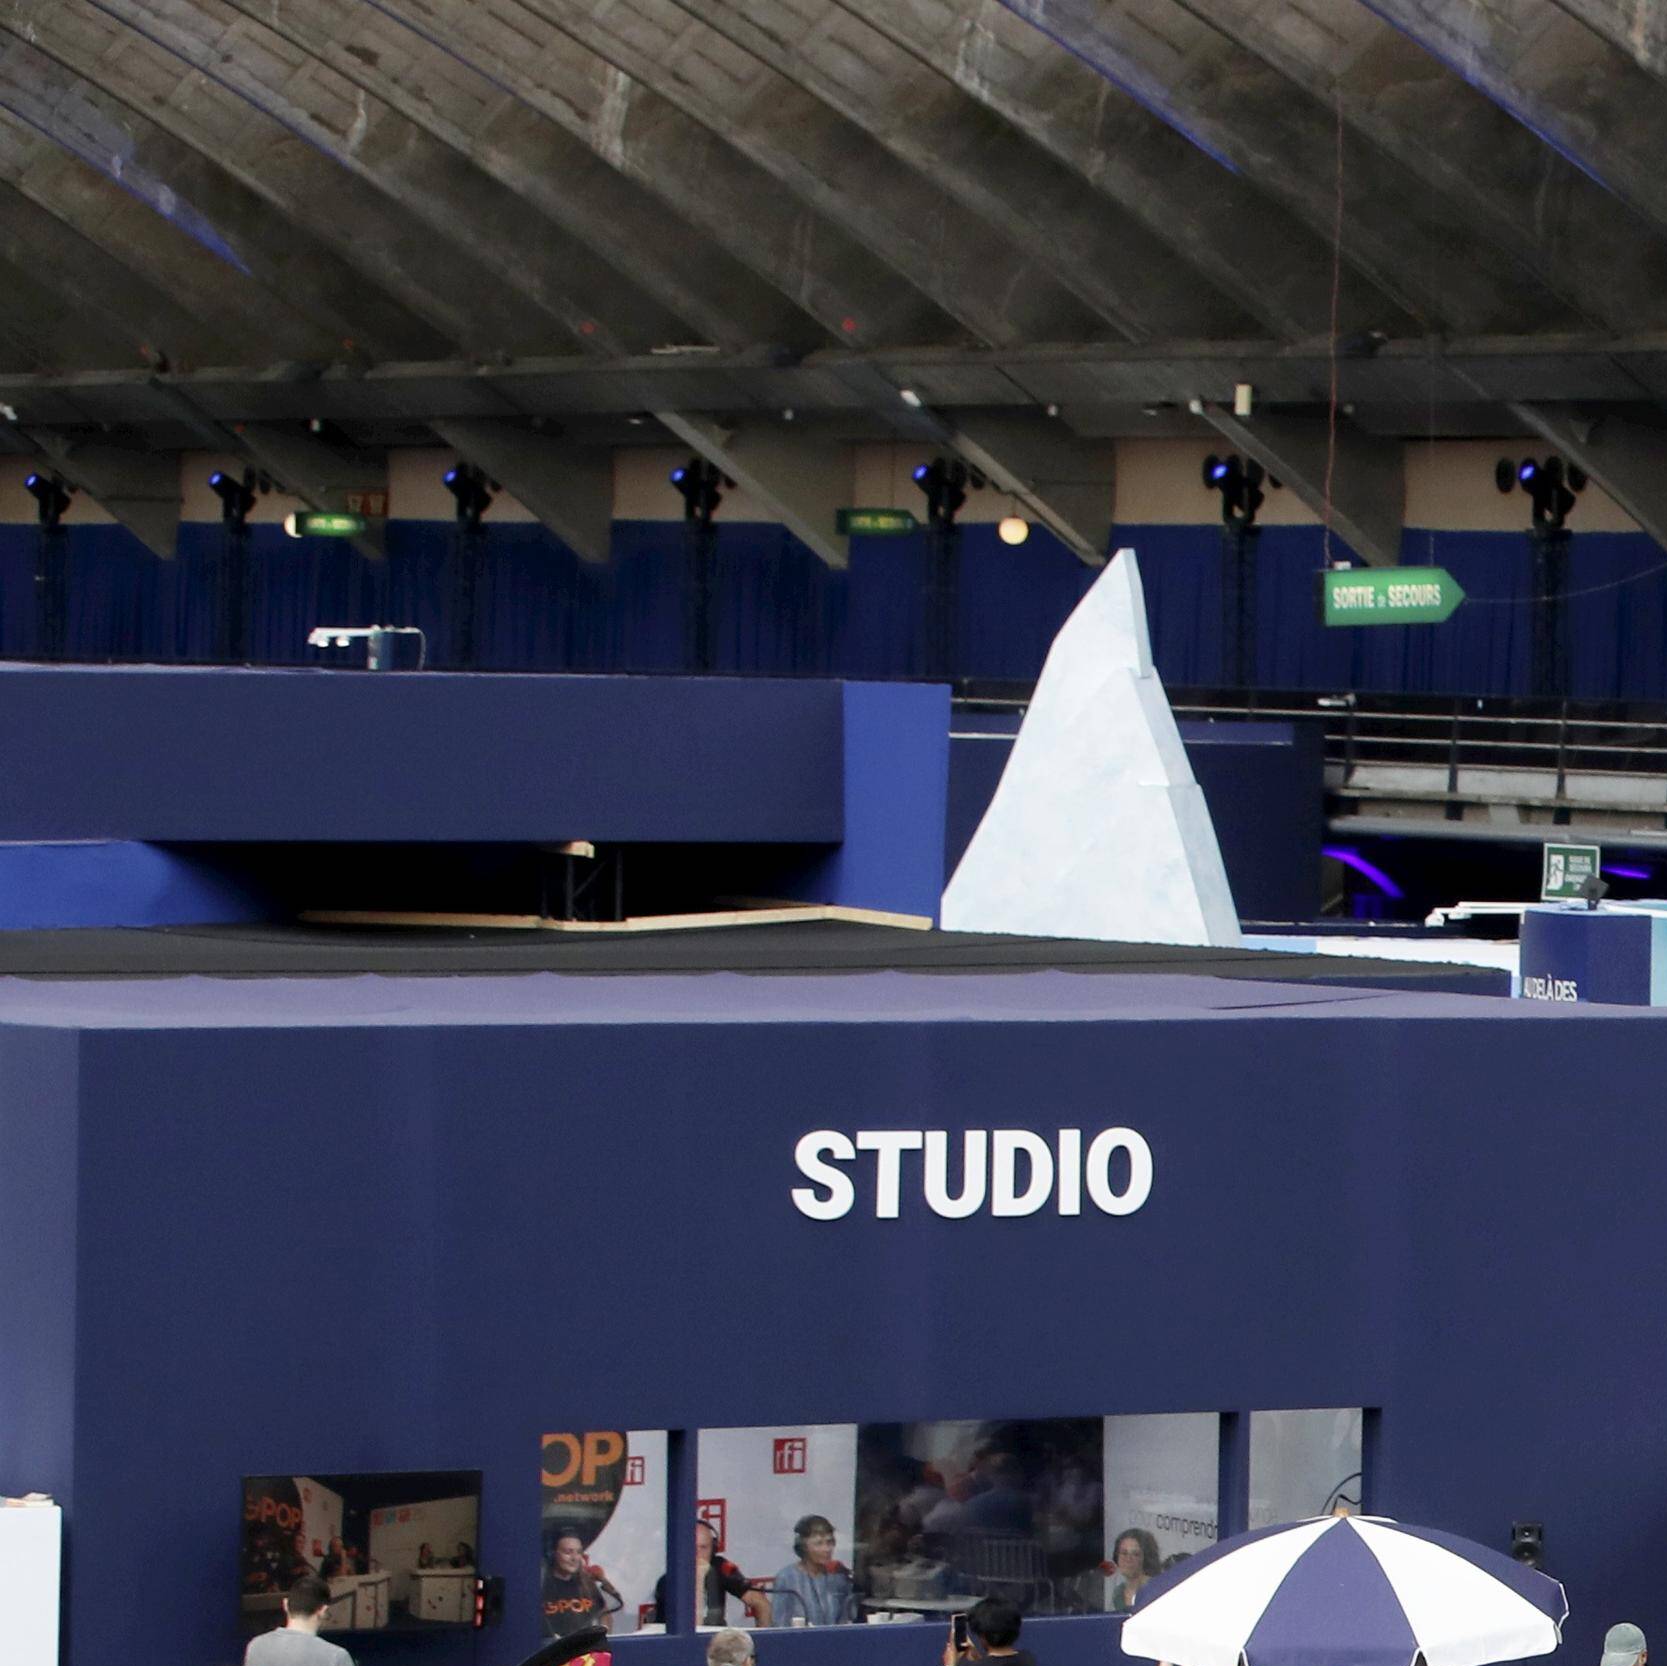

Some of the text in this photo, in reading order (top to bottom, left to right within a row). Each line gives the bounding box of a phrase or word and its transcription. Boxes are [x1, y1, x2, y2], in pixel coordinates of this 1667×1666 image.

[1332, 584, 1442, 609] SORTIE SECOURS
[1554, 980, 1578, 1001] DES
[790, 1125, 1154, 1221] STUDIO
[774, 1438, 806, 1473] rfi
